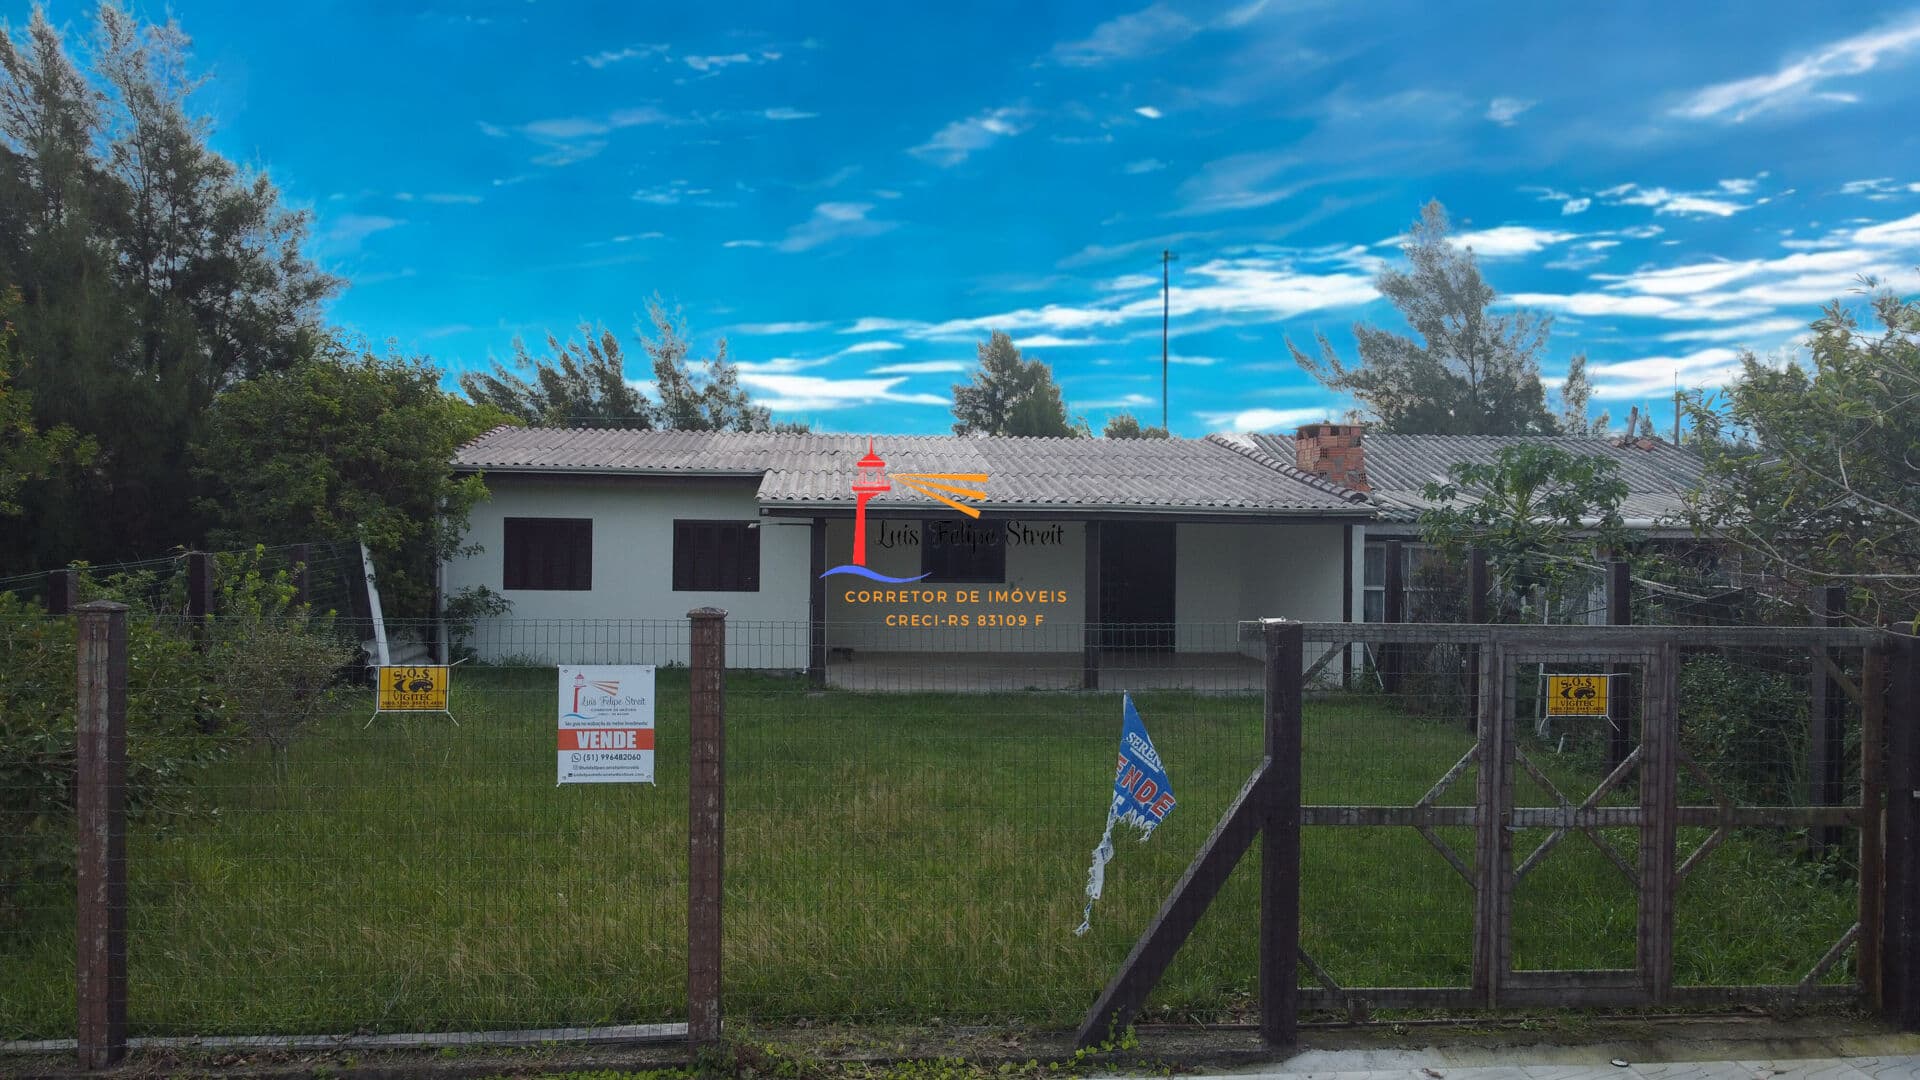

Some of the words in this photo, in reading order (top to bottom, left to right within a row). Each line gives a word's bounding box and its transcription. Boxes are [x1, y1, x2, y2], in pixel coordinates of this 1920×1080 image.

[393, 692, 433, 701] VIGITEC
[601, 696, 622, 706] Felipe
[625, 695, 645, 705] Streit
[576, 731, 637, 748] VENDE
[1126, 732, 1163, 770] SEREN
[583, 753, 599, 762] (51)
[601, 753, 641, 761] 996482060
